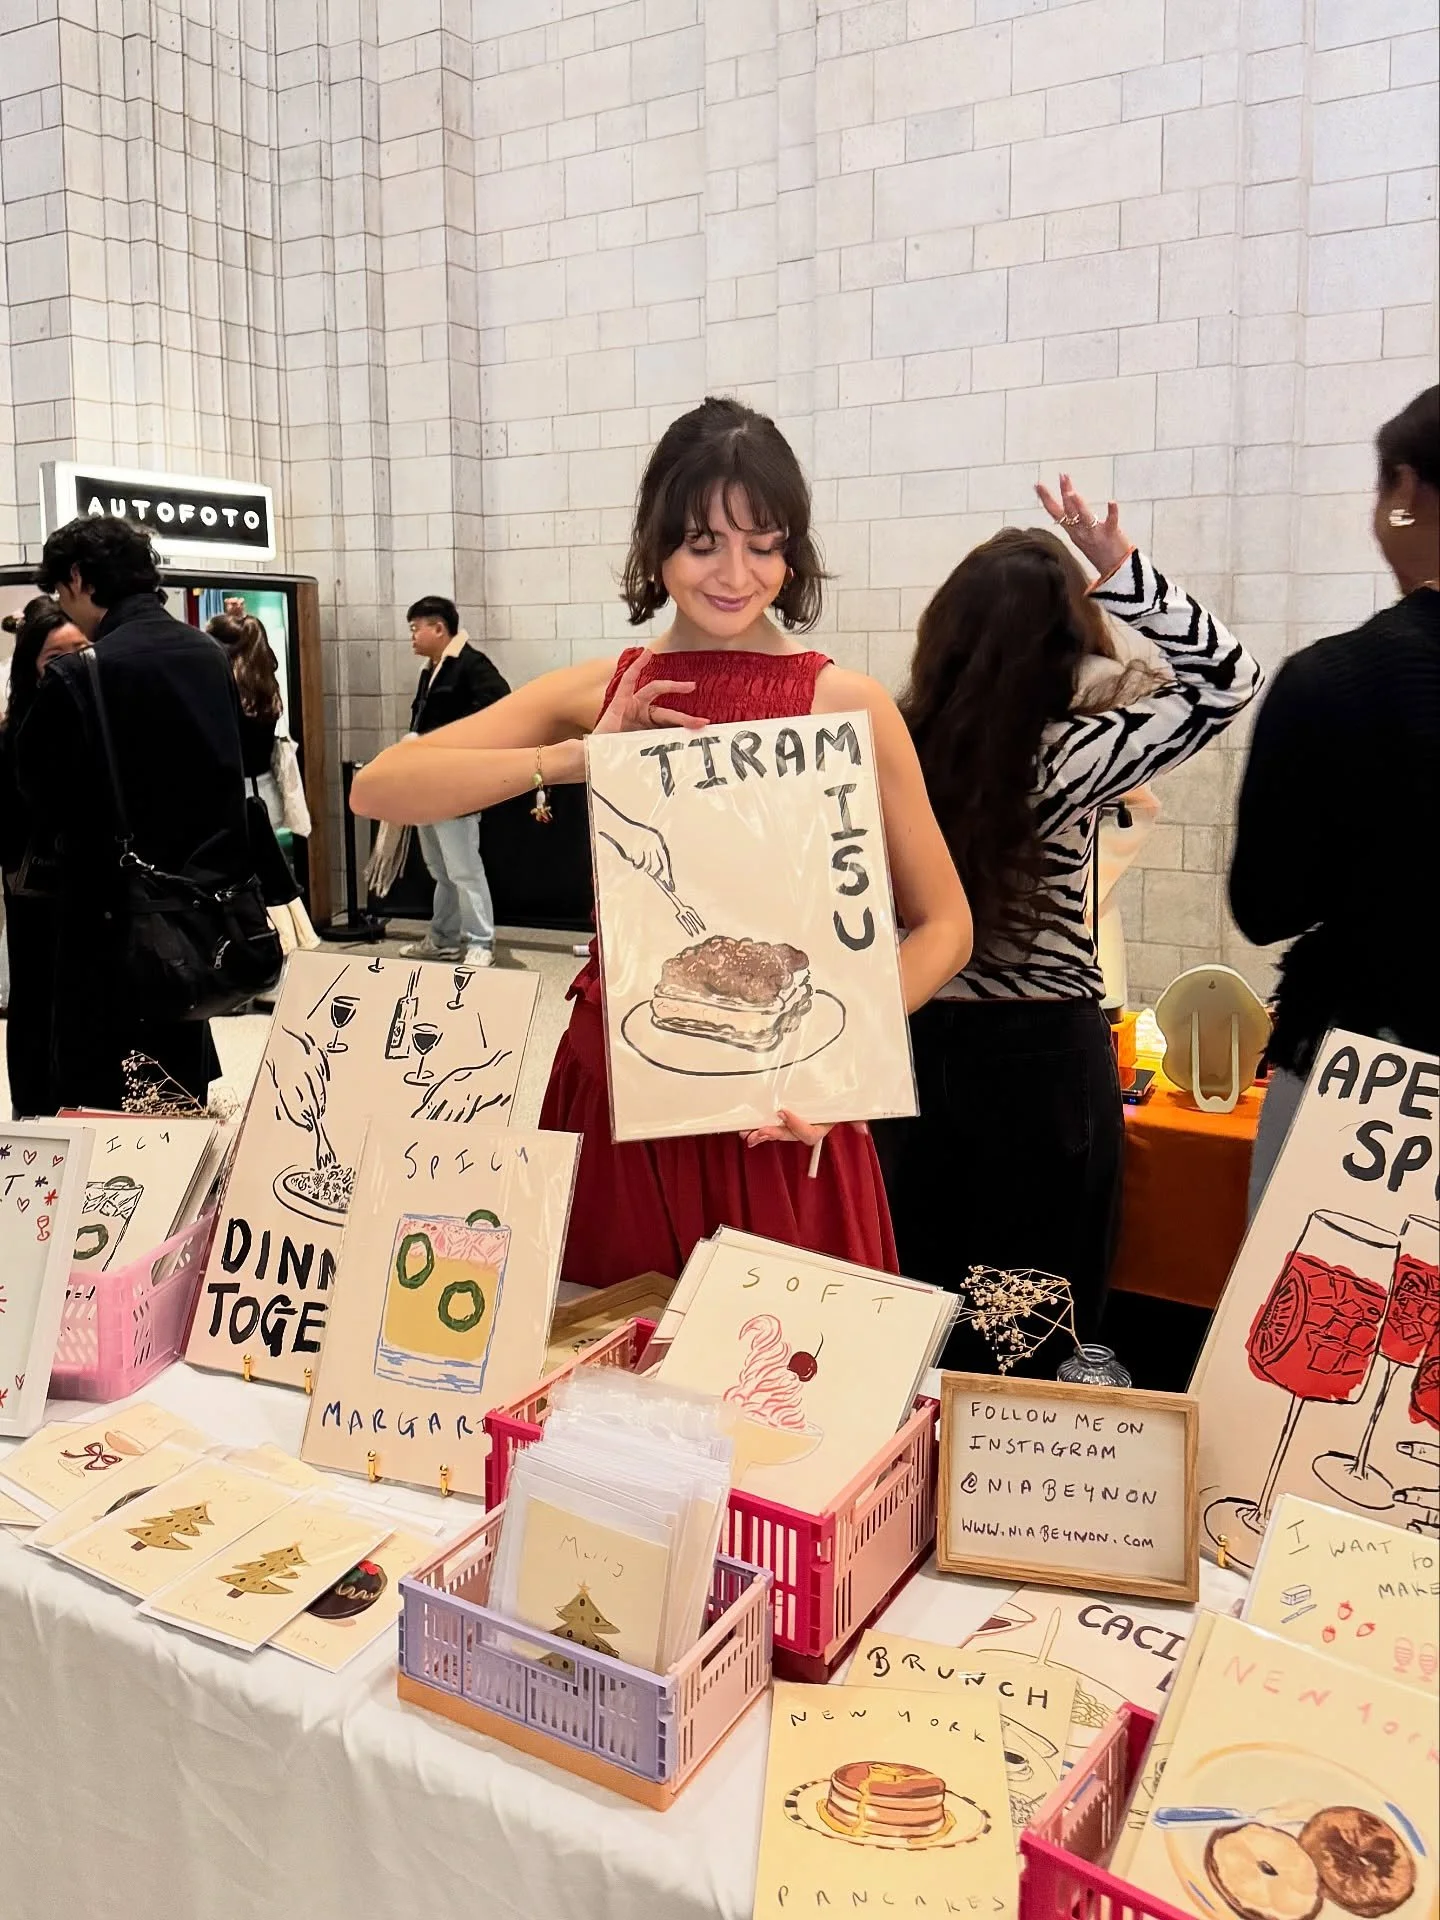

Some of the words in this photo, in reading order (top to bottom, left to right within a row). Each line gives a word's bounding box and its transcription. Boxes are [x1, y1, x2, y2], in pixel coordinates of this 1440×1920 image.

[88, 496, 260, 530] AUTOFOTO
[404, 1141, 529, 1180] SPICY
[742, 1267, 895, 1315] SOFT
[207, 1282, 329, 1358] TOGE
[971, 1401, 1057, 1424] FOLLOW
[1074, 1414, 1105, 1432] ME
[1117, 1421, 1144, 1434] ON
[969, 1435, 1116, 1459] INSTAGRAM
[1287, 1519, 1310, 1556] I
[1378, 1581, 1439, 1599] MAKE
[1078, 1604, 1186, 1662] CACI
[867, 1646, 1048, 1709] BRUNCH
[791, 1709, 867, 1727] NEW
[898, 1709, 985, 1743] YORK
[777, 1885, 1005, 1912] PANCAKES
